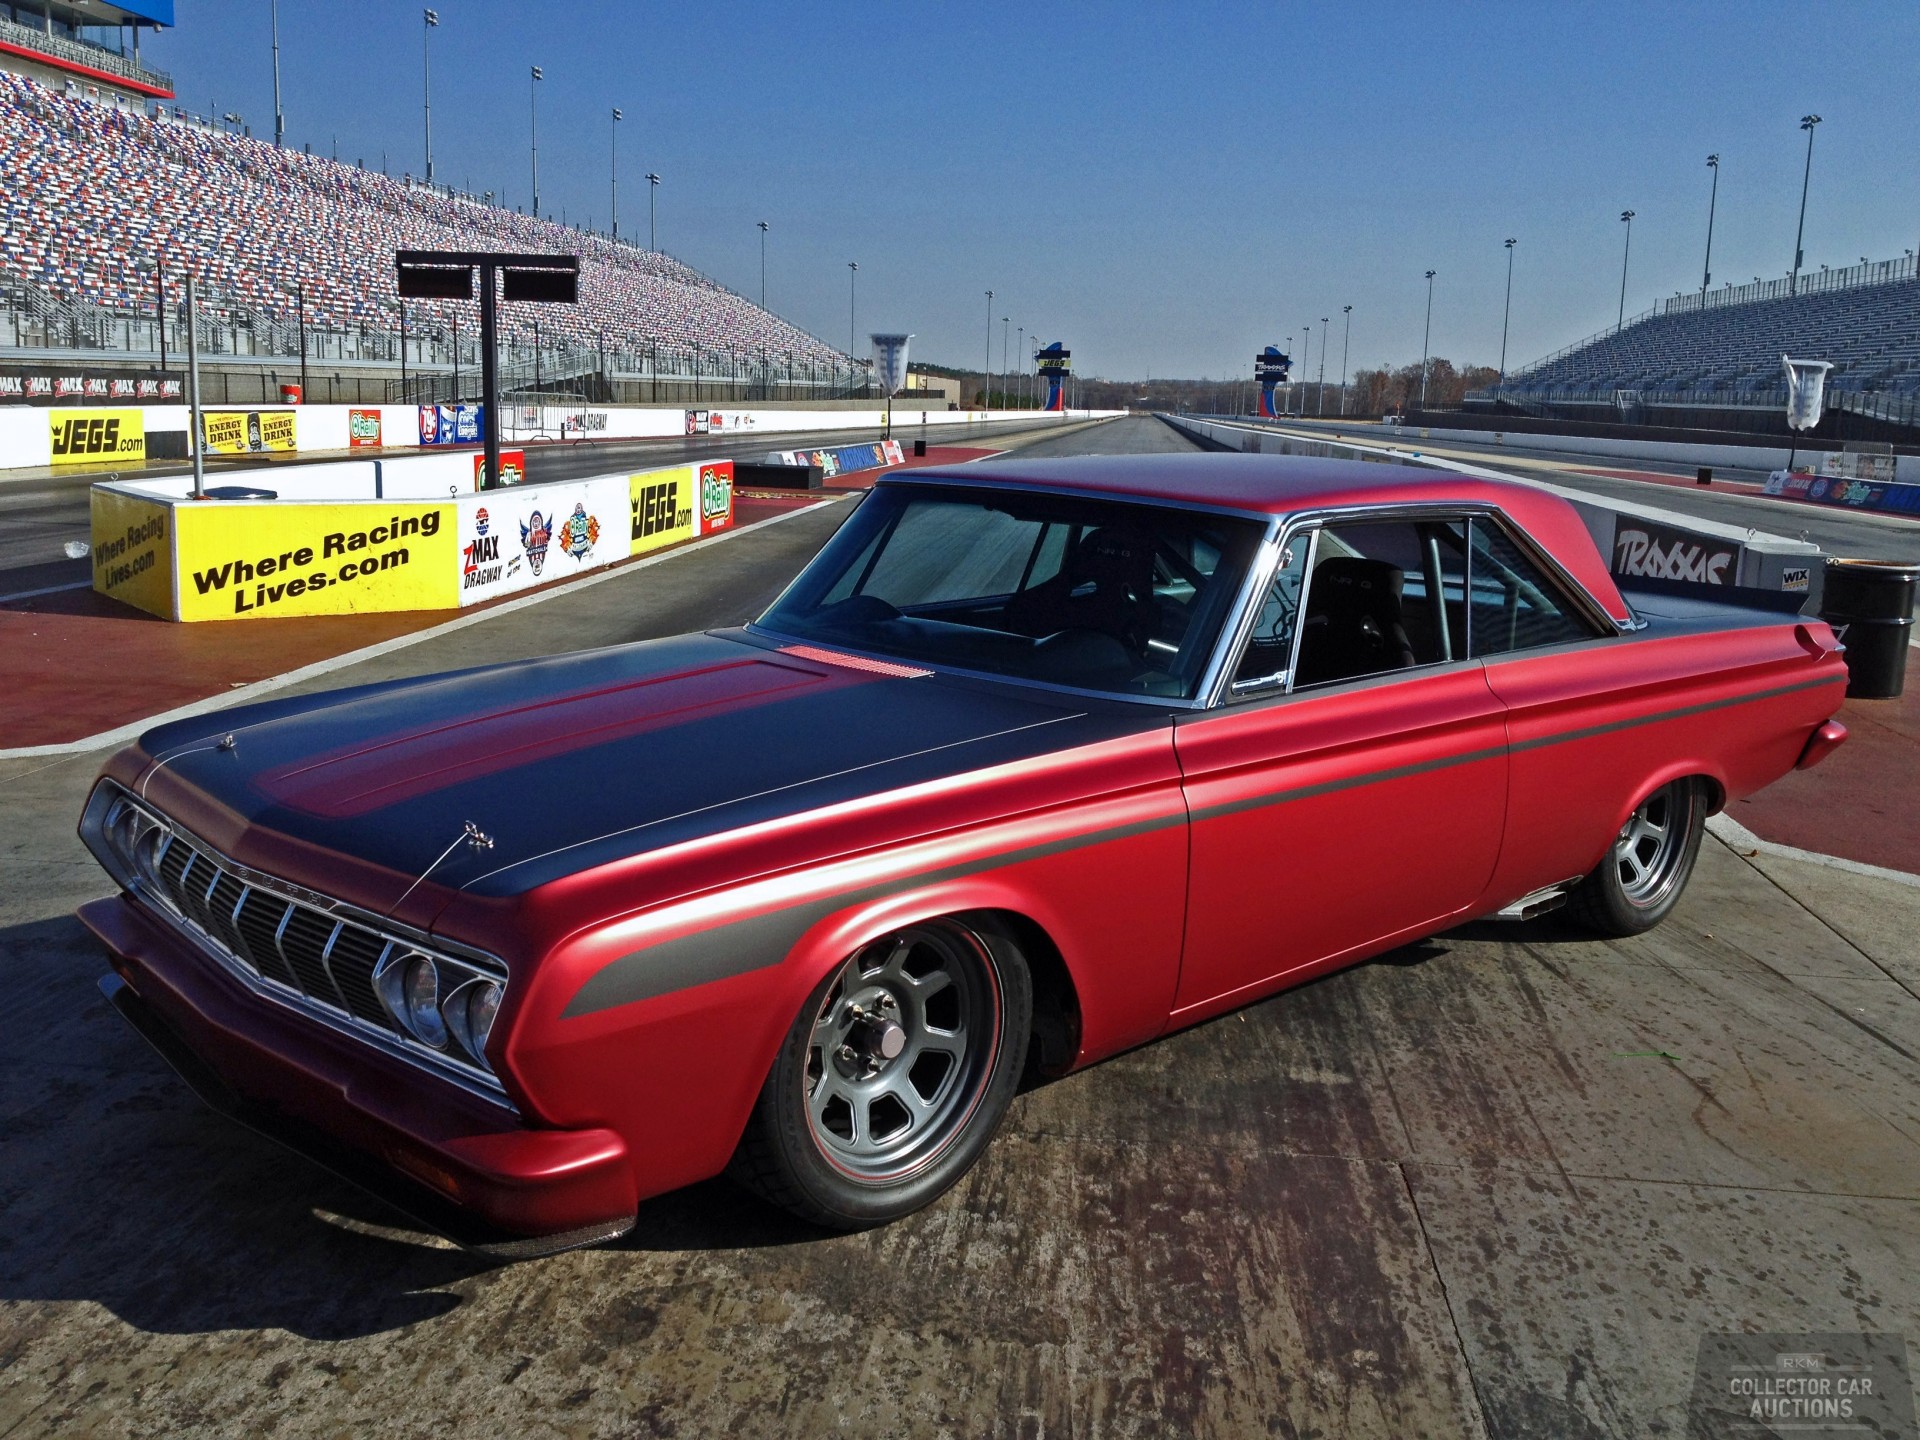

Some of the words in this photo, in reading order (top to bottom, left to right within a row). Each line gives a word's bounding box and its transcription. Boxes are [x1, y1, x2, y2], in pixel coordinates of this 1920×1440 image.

[0, 377, 22, 396] MAX
[52, 418, 143, 455] JEGS.com
[209, 419, 242, 432] ENERGY
[209, 429, 242, 443] DRINK
[263, 419, 293, 432] ENERGY
[264, 428, 293, 442] DRINK
[351, 413, 379, 439] O'Reilly
[703, 475, 731, 514] O'Reilly
[632, 481, 692, 541] JEGS.com
[95, 538, 125, 568] Where
[127, 514, 164, 549] Racing
[193, 545, 314, 595] Where
[322, 511, 441, 559] Racing
[105, 549, 155, 590] Lives.com
[1617, 529, 1733, 585] TRAXXAS
[234, 547, 410, 614] Lives.com
[464, 565, 503, 590] DRAGWAY
[1783, 569, 1808, 583] WIX
